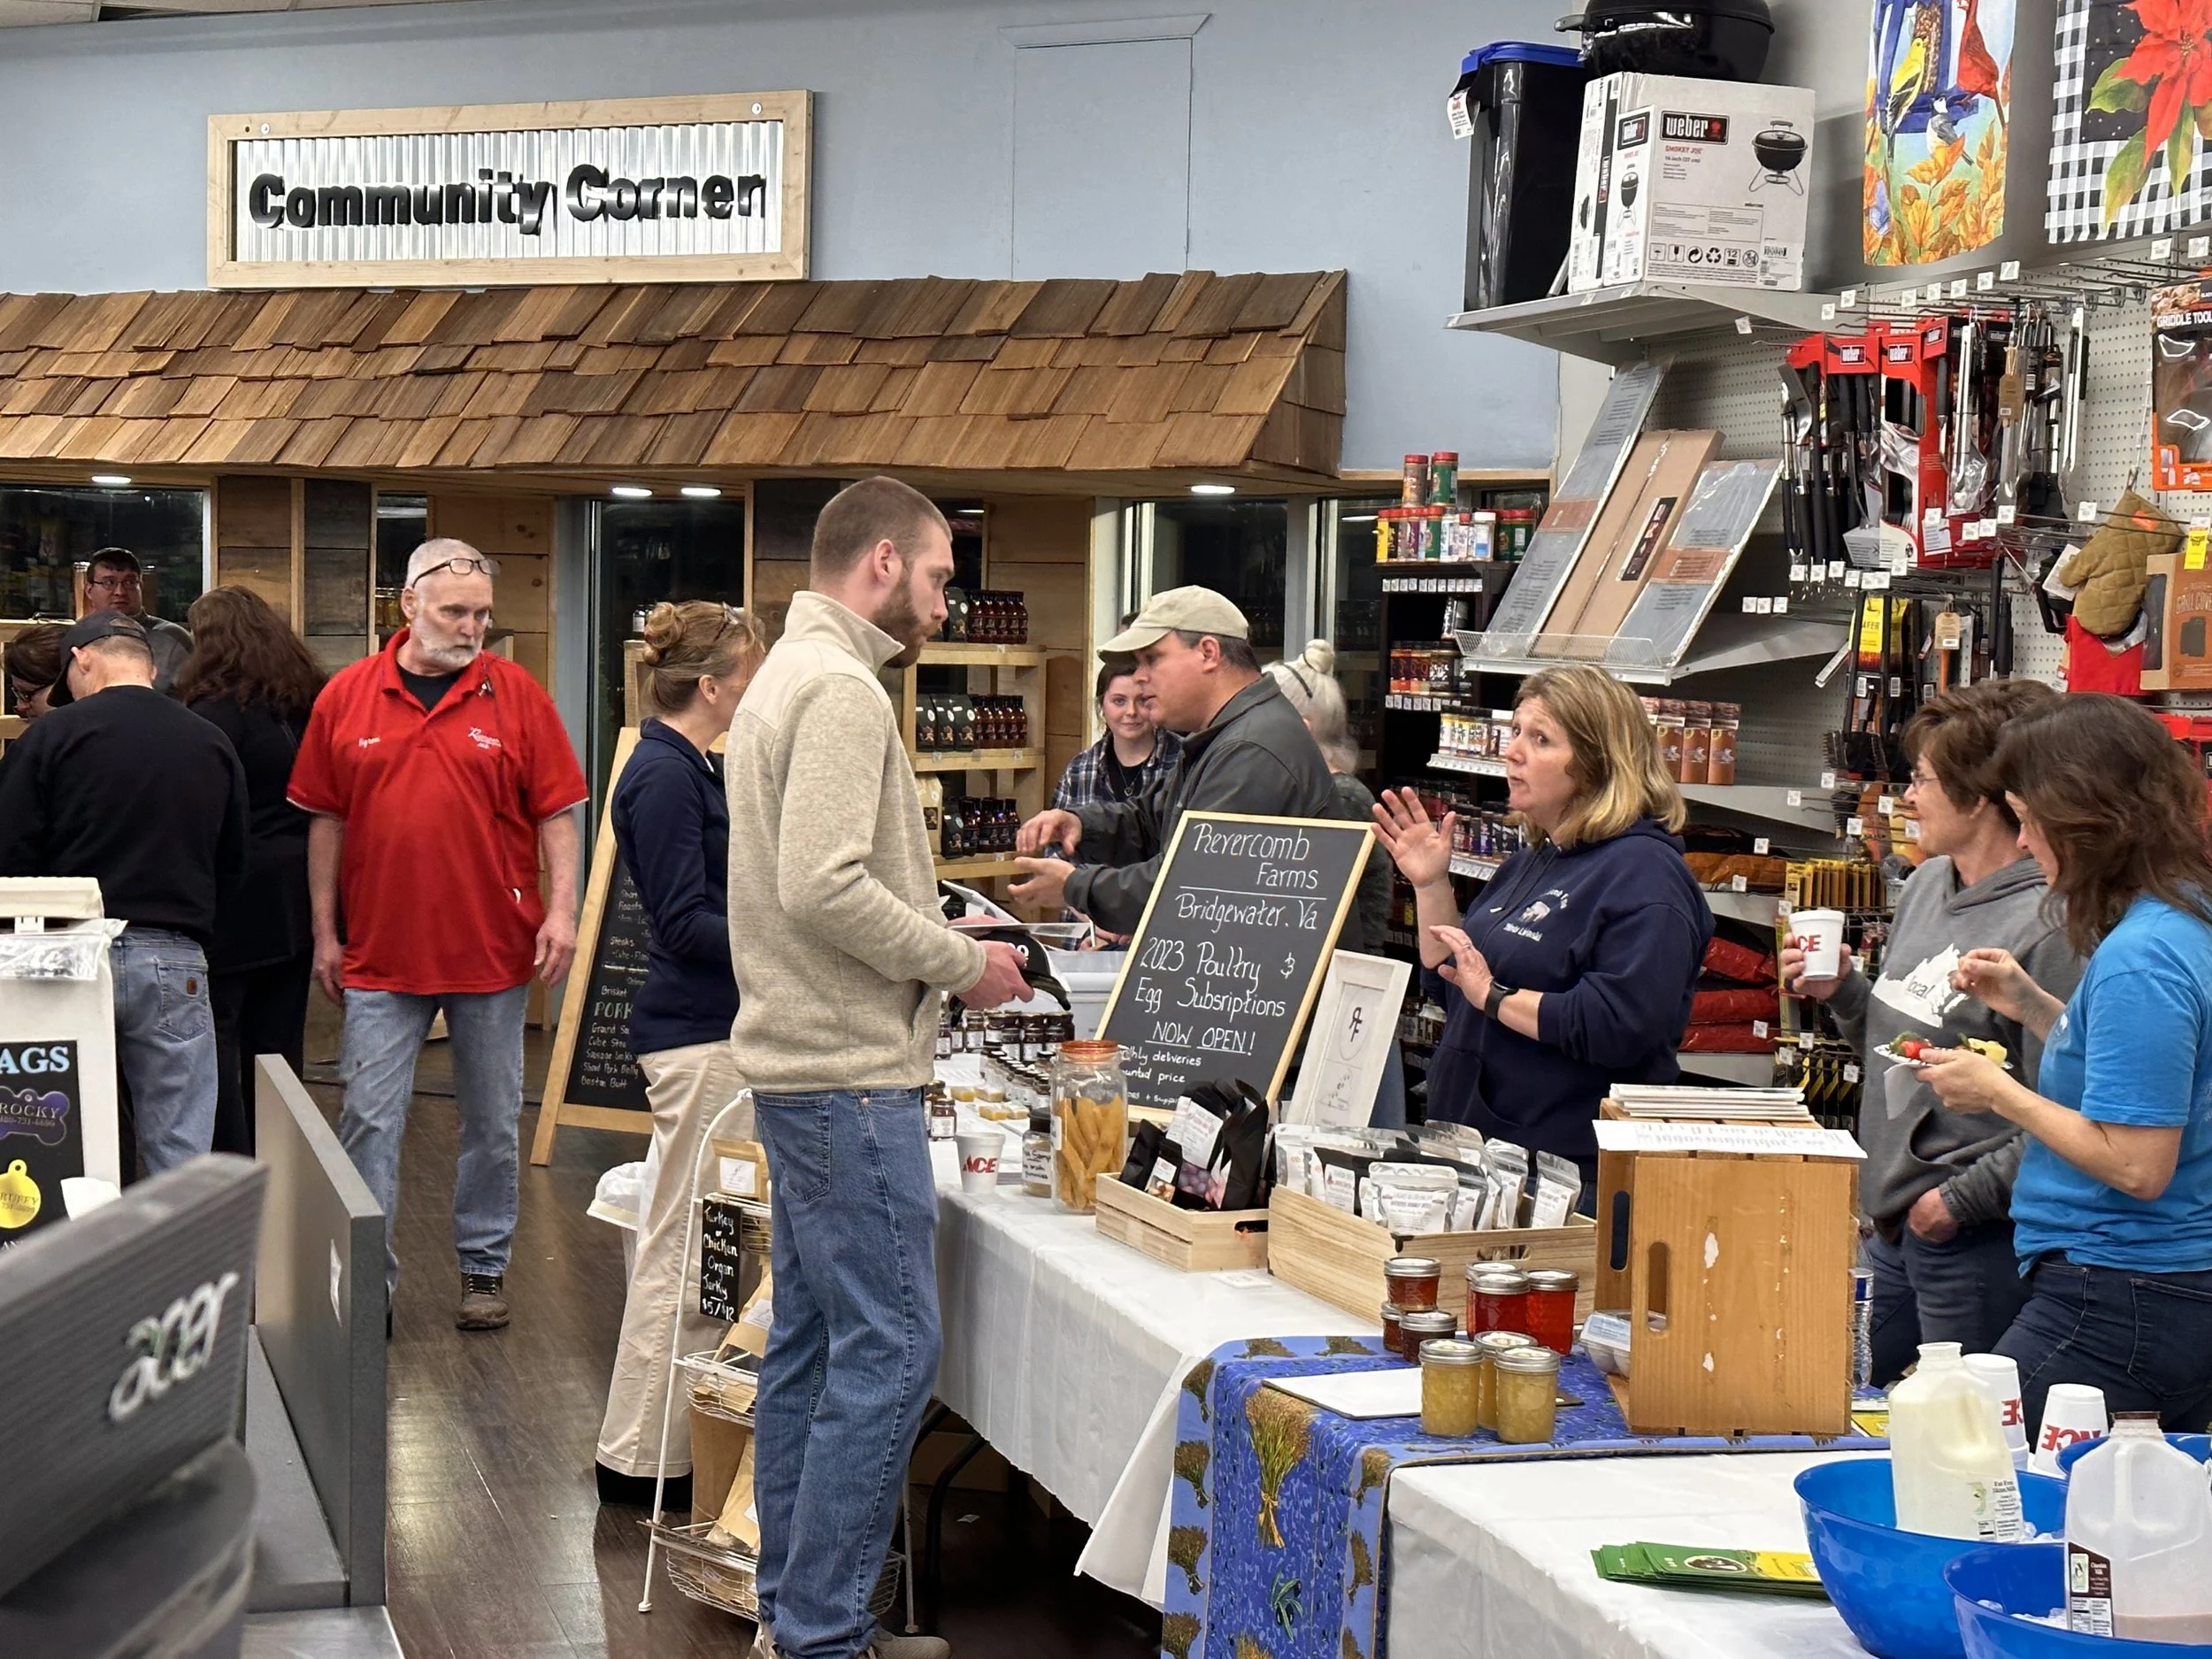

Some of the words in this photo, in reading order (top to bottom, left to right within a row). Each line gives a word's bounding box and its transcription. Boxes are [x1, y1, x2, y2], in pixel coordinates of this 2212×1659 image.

[1666, 115, 1709, 138] weber
[249, 167, 556, 235] Community
[565, 163, 766, 223] Corner
[2157, 312, 2192, 328] GRIDDLE
[1862, 621, 1880, 631] AFER
[1193, 823, 1310, 861] Revercomb
[1256, 863, 1318, 889] Farms
[1298, 899, 1317, 930] Va
[1798, 934, 1823, 952] CE
[1140, 937, 1185, 972] 2023
[1196, 941, 1261, 994] Poultry
[594, 1002, 634, 1019] PORK
[1134, 977, 1162, 1014] Egg
[1177, 978, 1286, 1022] Subsriptions
[588, 1036, 607, 1047] Cube
[611, 1038, 626, 1048] Stea
[1153, 1020, 1193, 1046] NOW
[1202, 1027, 1256, 1056] OPEN!
[580, 1075, 606, 1087] Boston
[610, 1077, 628, 1087] Butt
[1157, 1071, 1186, 1085] price
[0, 1103, 60, 1120] ROCKY
[963, 1155, 998, 1173] ACE
[704, 1207, 734, 1236] Turkey
[703, 1235, 738, 1257] Chicken
[708, 1255, 734, 1282] Organ
[703, 1273, 728, 1301] Jerky
[107, 1271, 240, 1422] acer
